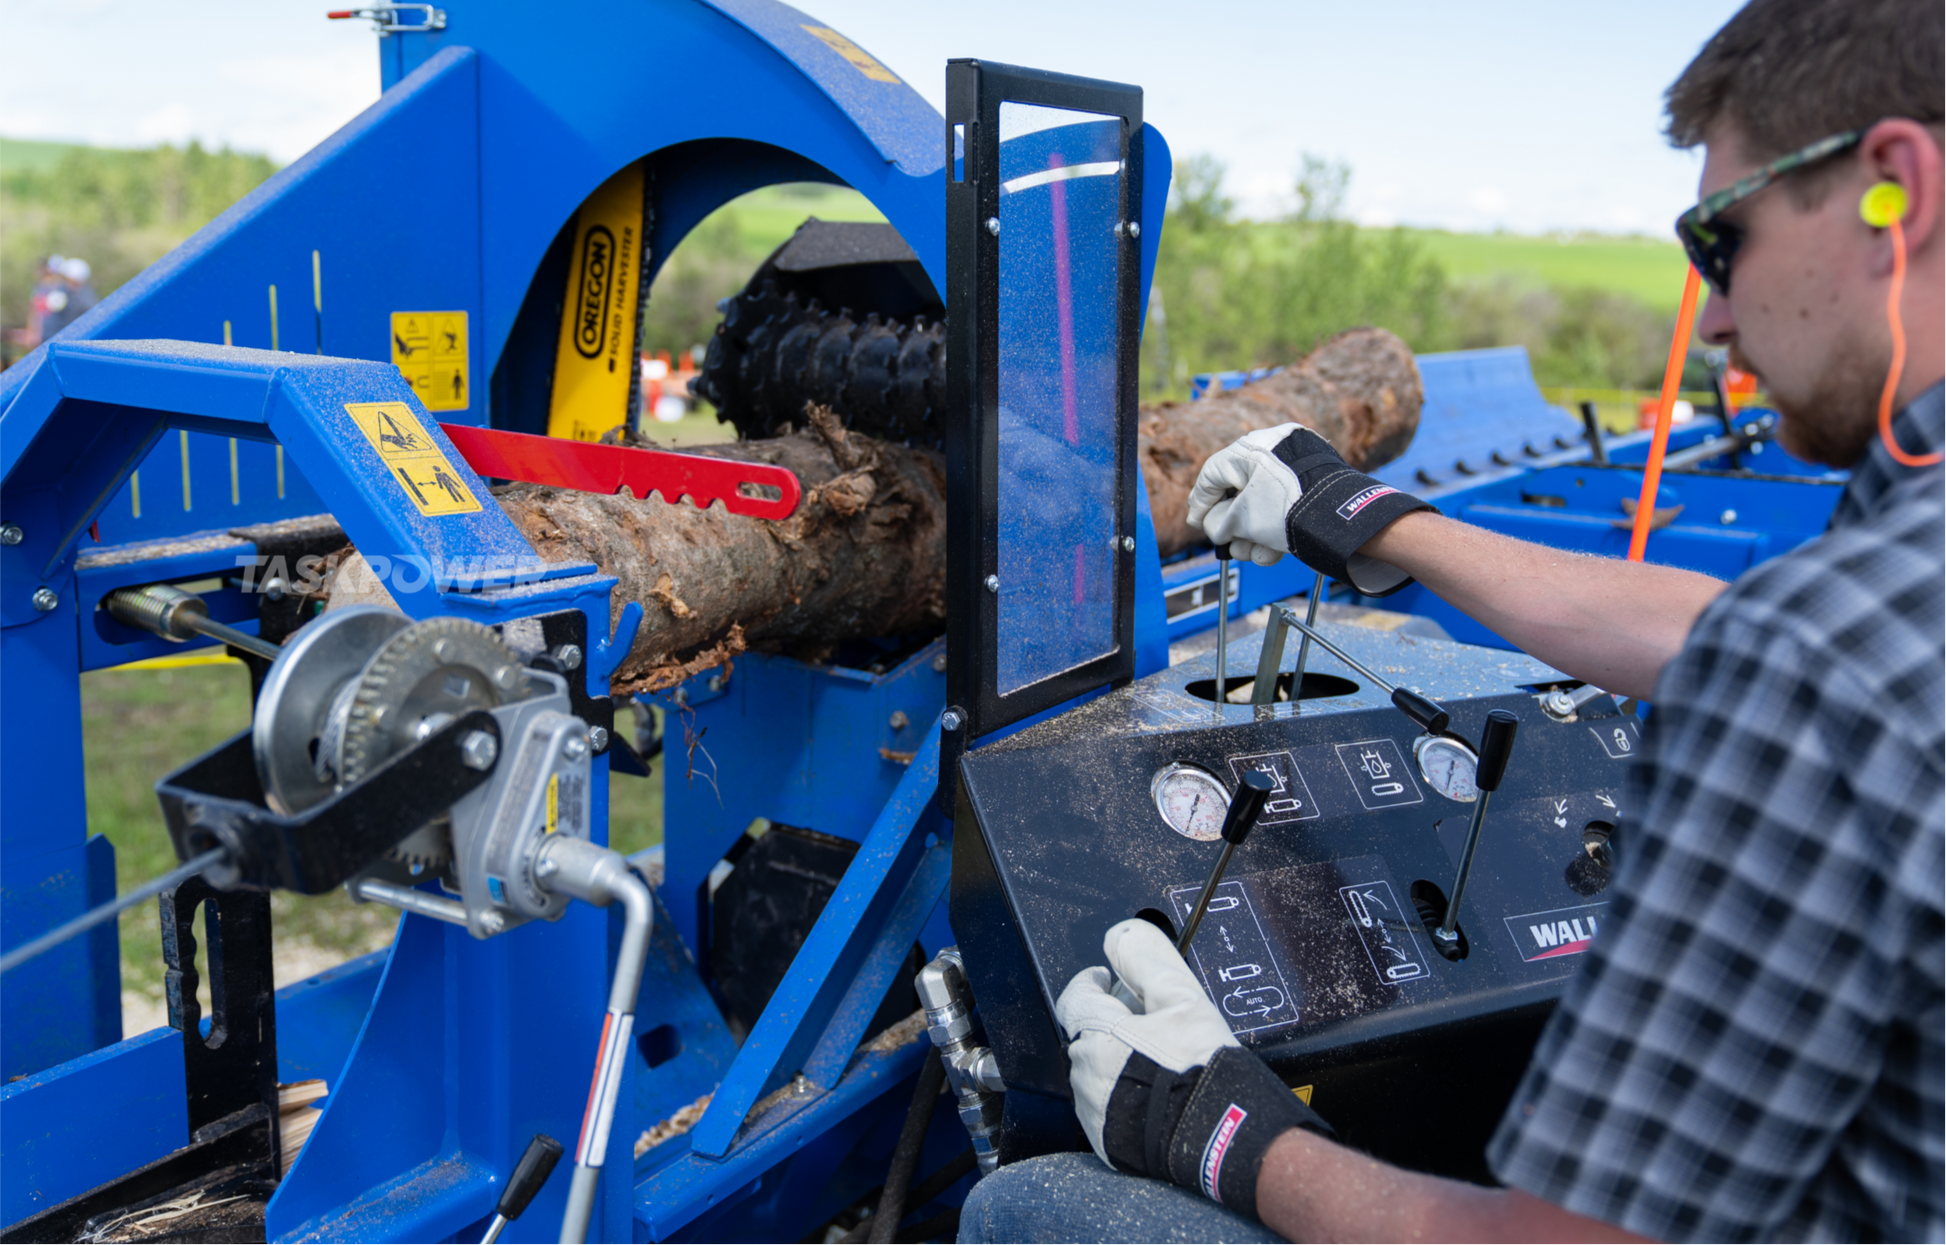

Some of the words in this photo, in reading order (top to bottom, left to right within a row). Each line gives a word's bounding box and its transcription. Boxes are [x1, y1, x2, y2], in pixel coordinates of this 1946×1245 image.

[582, 241, 608, 345] OREGON
[610, 313, 622, 356] SOLID
[616, 226, 633, 310] HARVESTER
[1529, 916, 1599, 948] WALL
[1246, 996, 1263, 1006] AUTO
